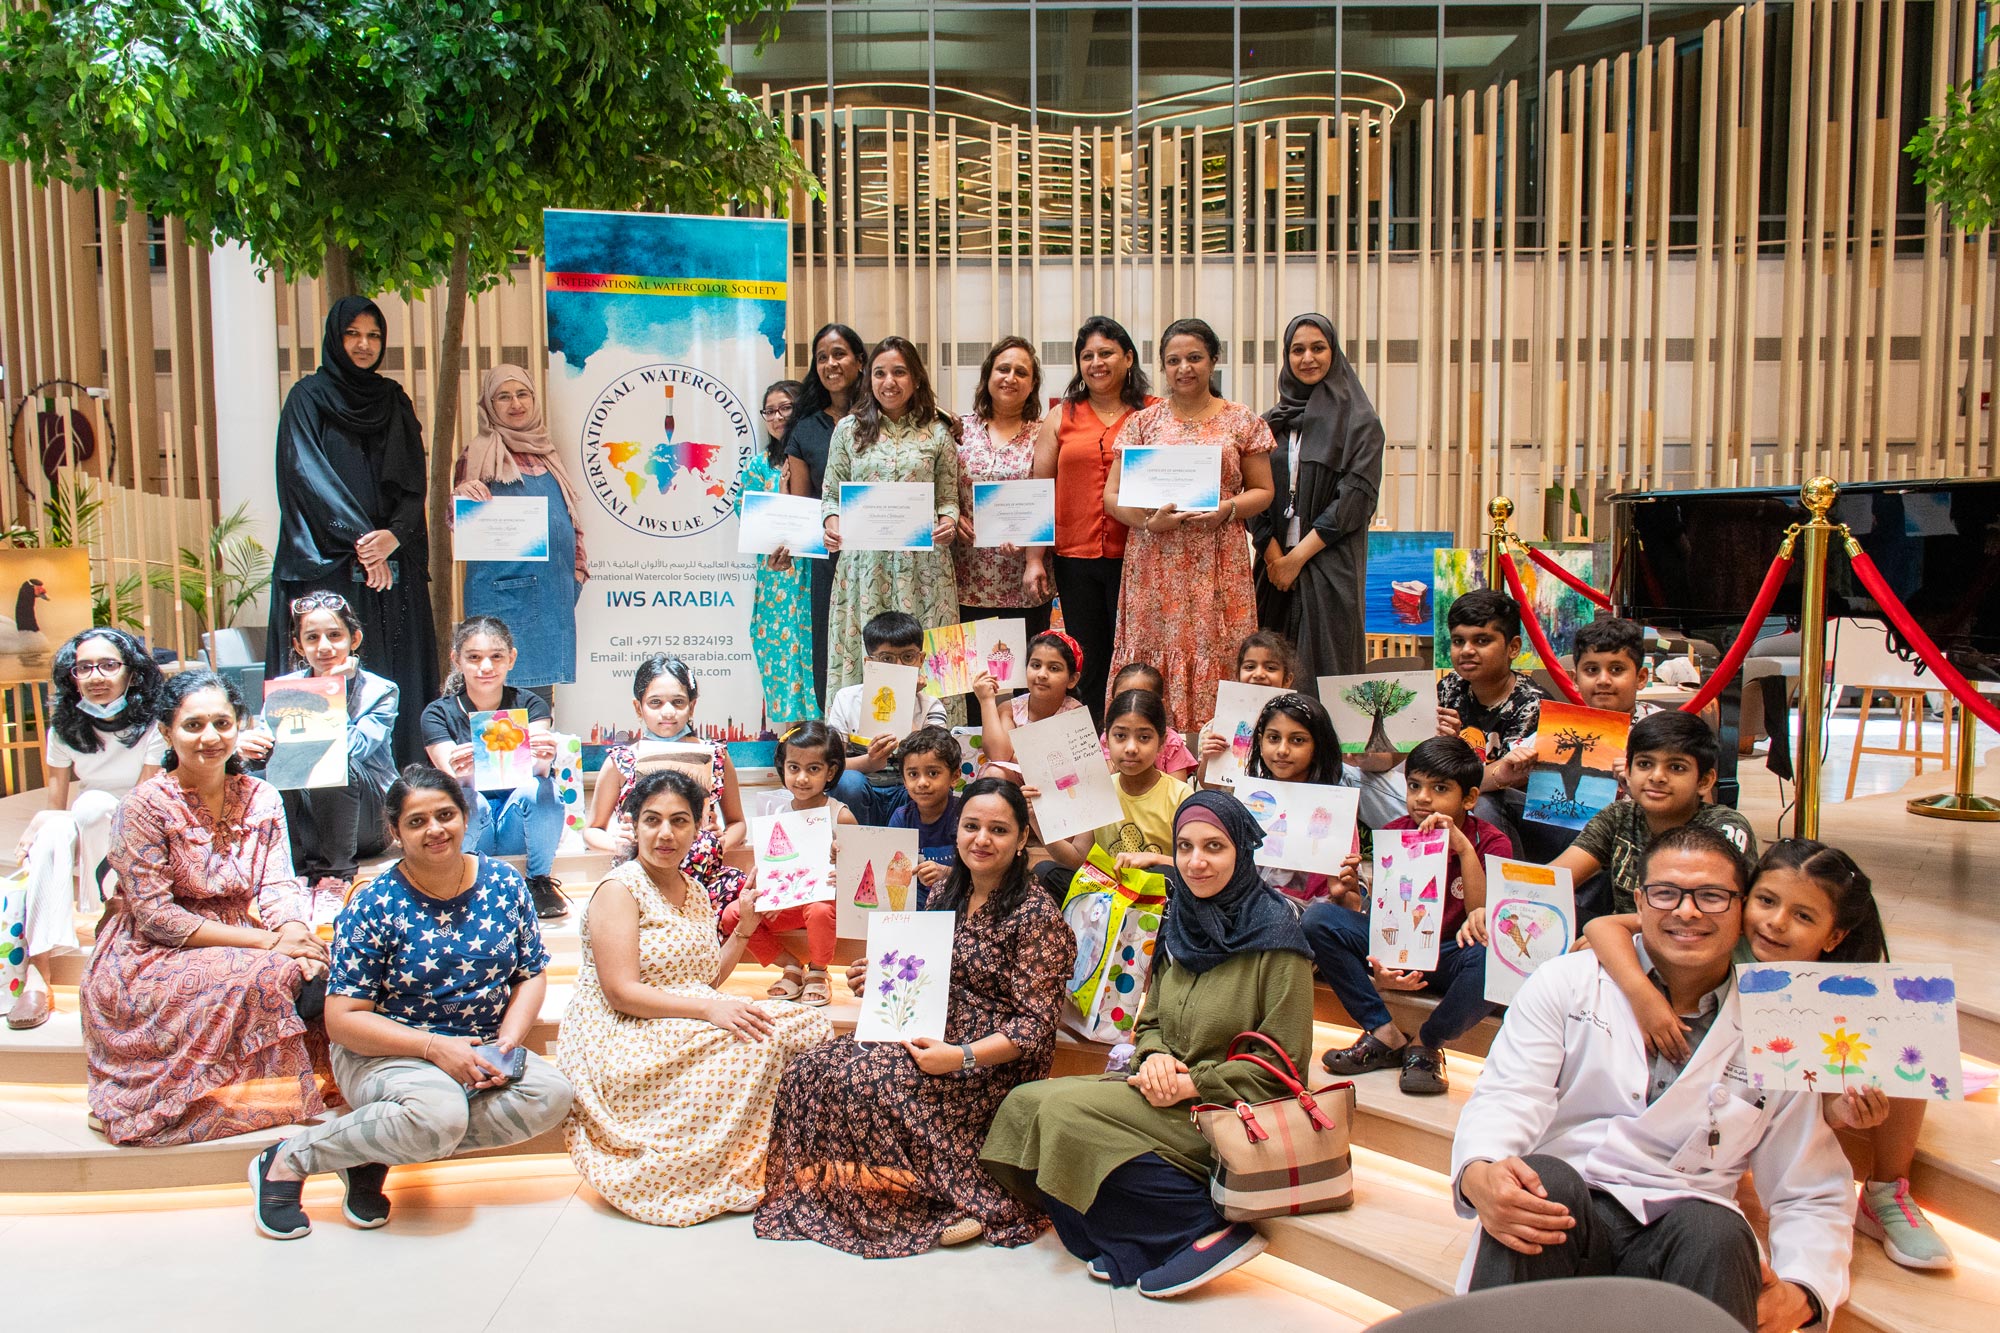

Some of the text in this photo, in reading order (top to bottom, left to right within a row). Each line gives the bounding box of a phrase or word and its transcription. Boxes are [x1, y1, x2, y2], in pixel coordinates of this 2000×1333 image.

[556, 276, 778, 295] INTERNATIONAL WATERCOLOR SOCIETY
[587, 381, 636, 516] INTERNATIONAL
[640, 369, 748, 437] WATERCOLOR
[638, 515, 704, 532] IWS UAE
[590, 572, 757, 583] ernational Watercolor Society (IWS) UA
[607, 591, 735, 608] IWS ARABIA
[610, 636, 733, 647] Call +971 52 8324193
[590, 652, 628, 662] Email:
